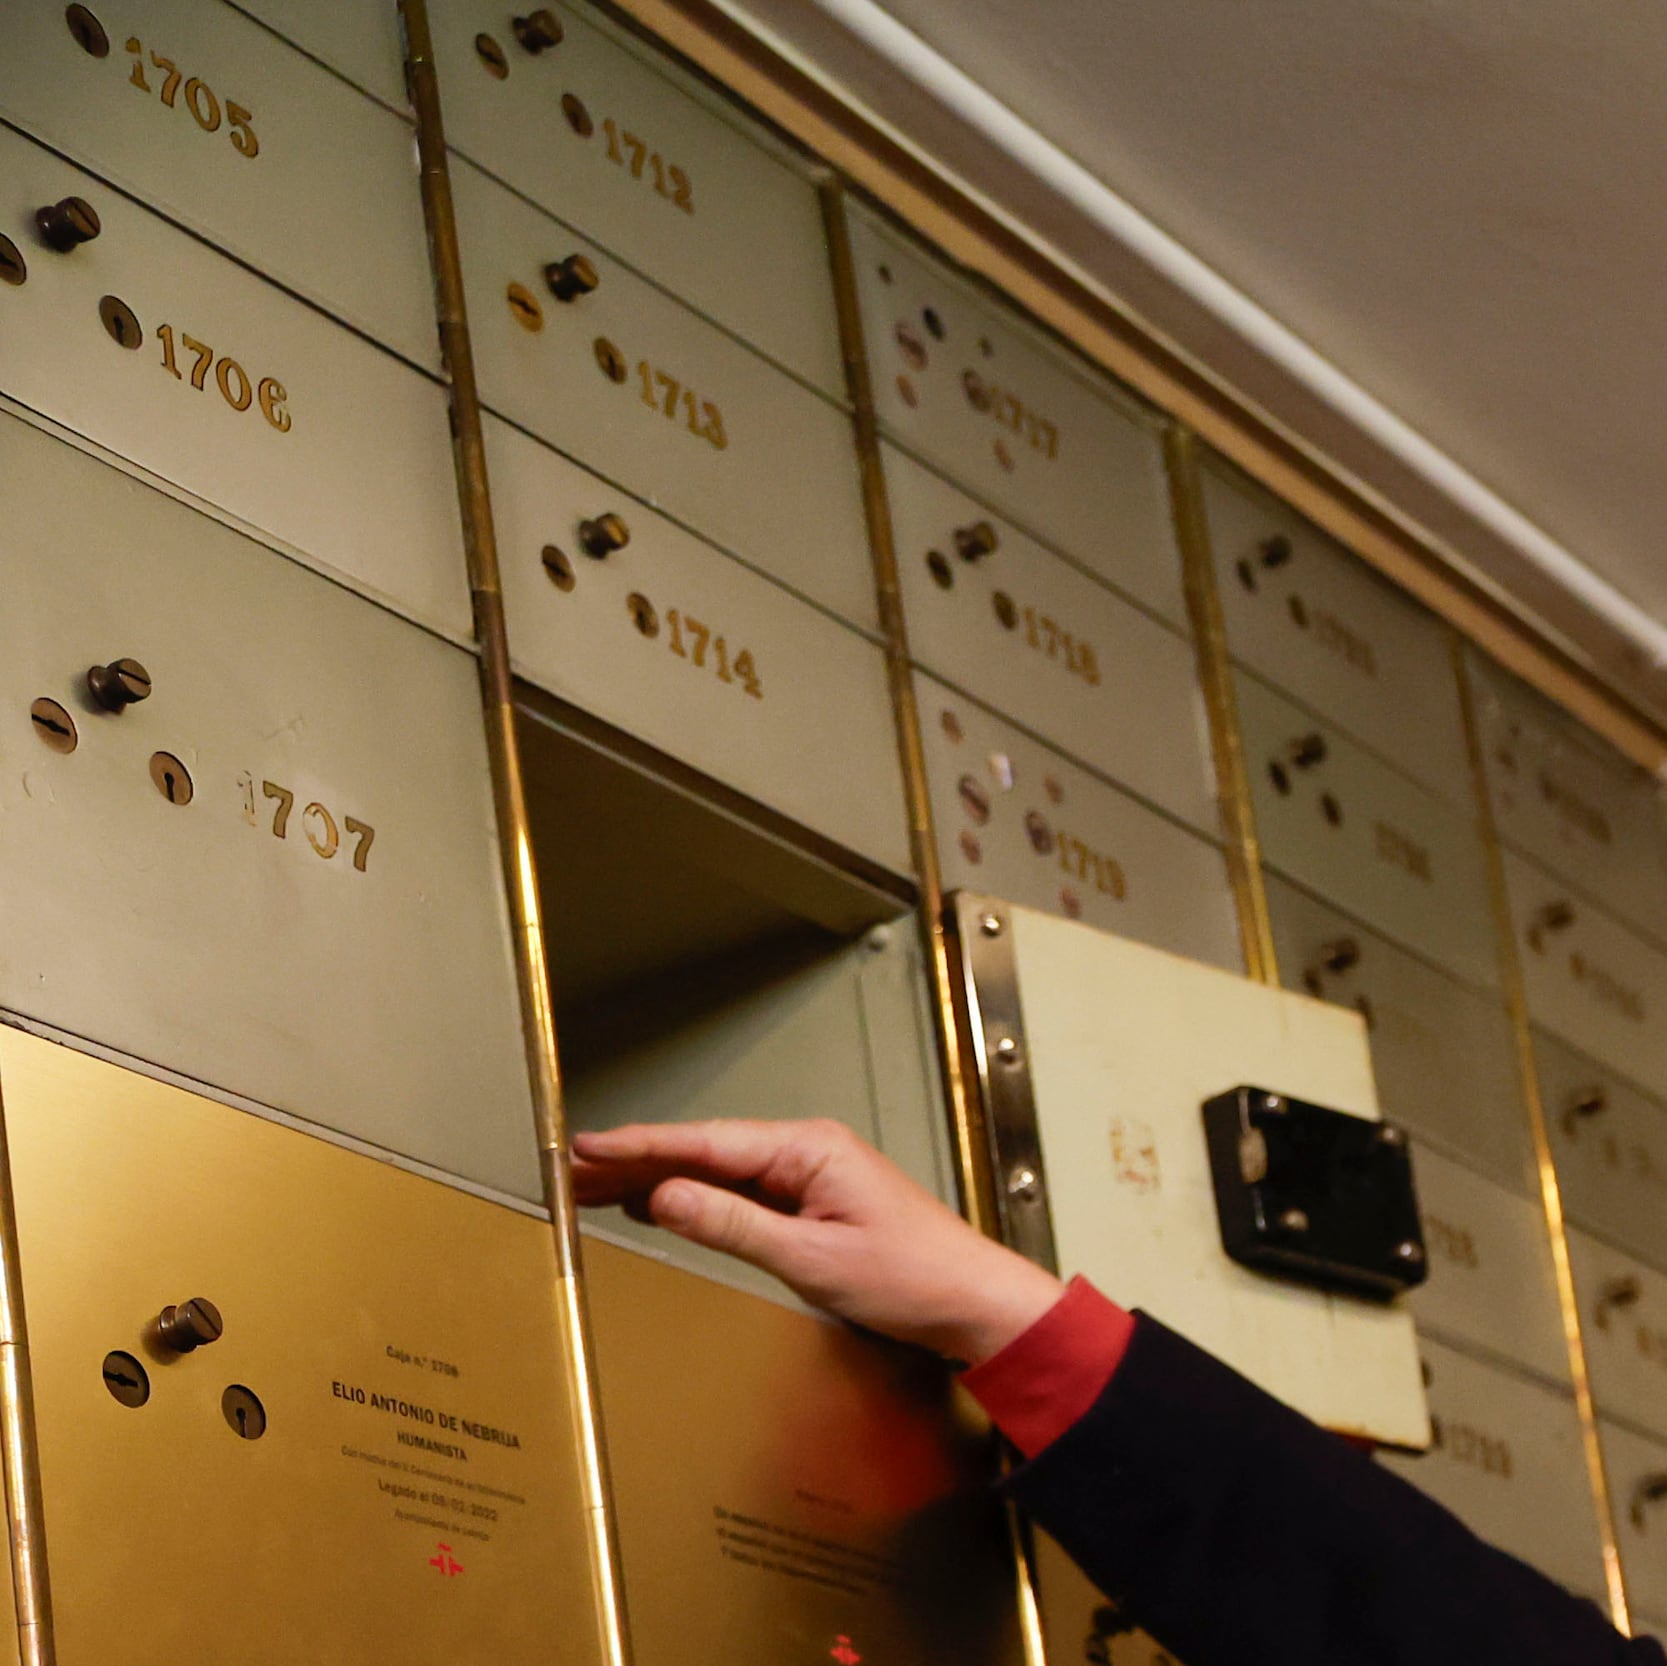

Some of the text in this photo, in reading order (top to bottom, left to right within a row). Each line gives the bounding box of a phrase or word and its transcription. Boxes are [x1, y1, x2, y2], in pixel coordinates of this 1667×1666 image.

[125, 36, 259, 159] 1705
[603, 117, 695, 217] 1712
[156, 323, 291, 433] 1706
[637, 360, 729, 450] 1713
[666, 607, 763, 700] 1714
[237, 770, 375, 873] 1707
[332, 1381, 365, 1404] ELIO
[371, 1394, 434, 1424] ANTONIO
[439, 1413, 457, 1431] DE
[397, 1432, 467, 1460] HUMANISTA
